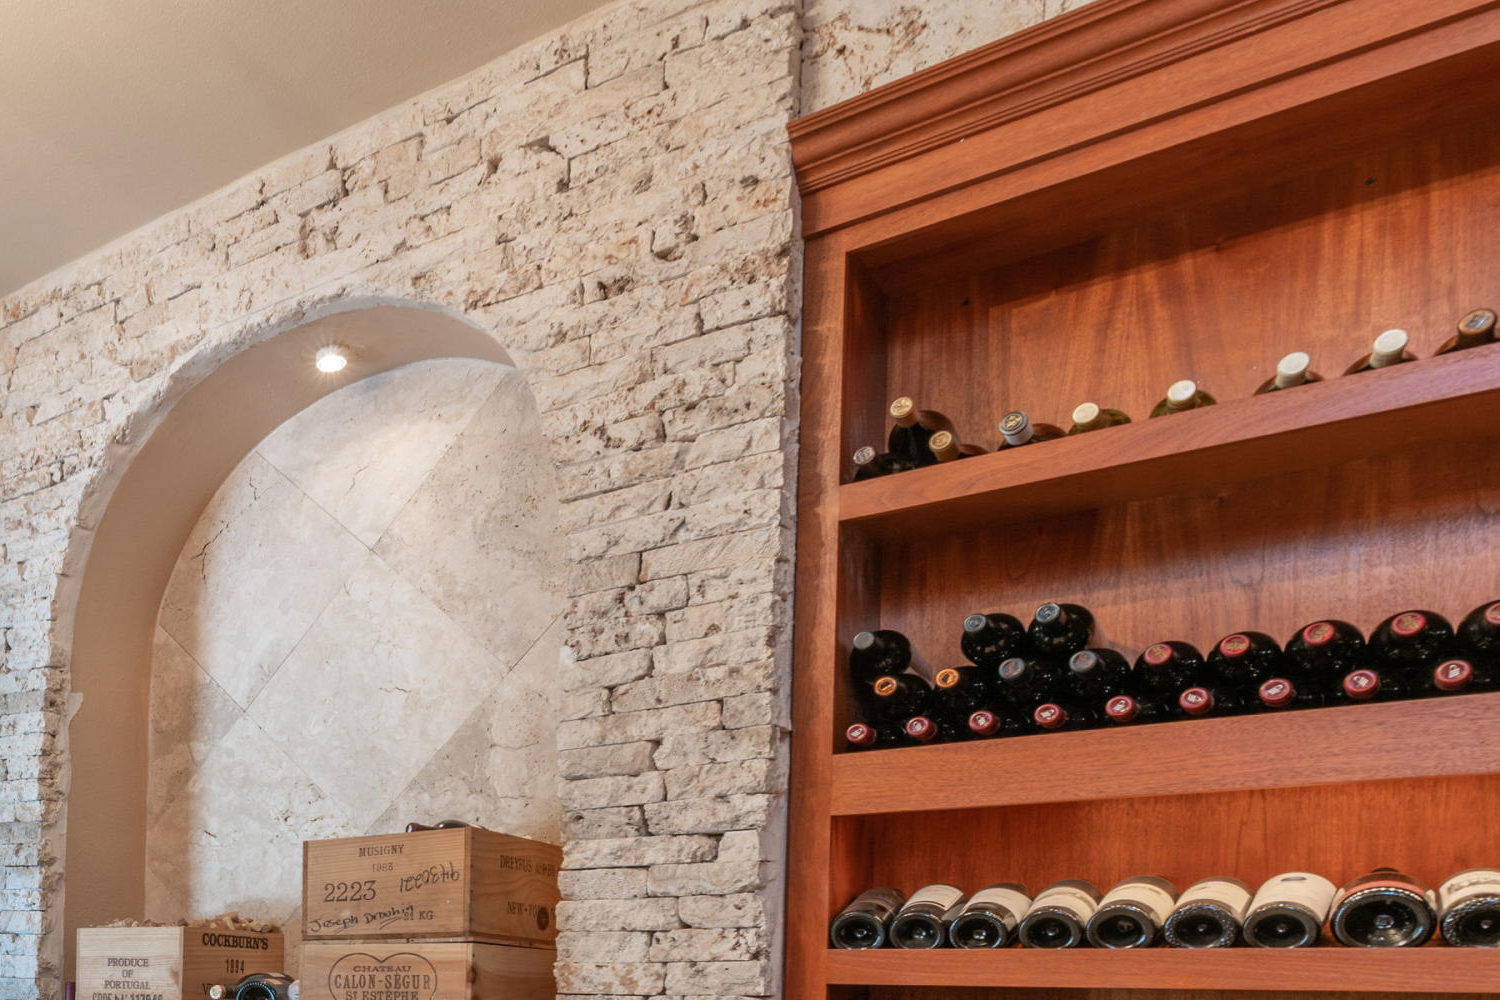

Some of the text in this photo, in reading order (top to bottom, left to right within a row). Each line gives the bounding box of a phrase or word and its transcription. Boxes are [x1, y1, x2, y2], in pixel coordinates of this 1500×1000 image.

[358, 844, 405, 857] MUSIGNY
[323, 880, 377, 903] 2223
[419, 910, 434, 920] KG
[202, 933, 268, 950] COCKBURN'S
[108, 958, 148, 967] PRODUCE
[121, 969, 133, 978] OF
[104, 980, 151, 990] PORTUGAL
